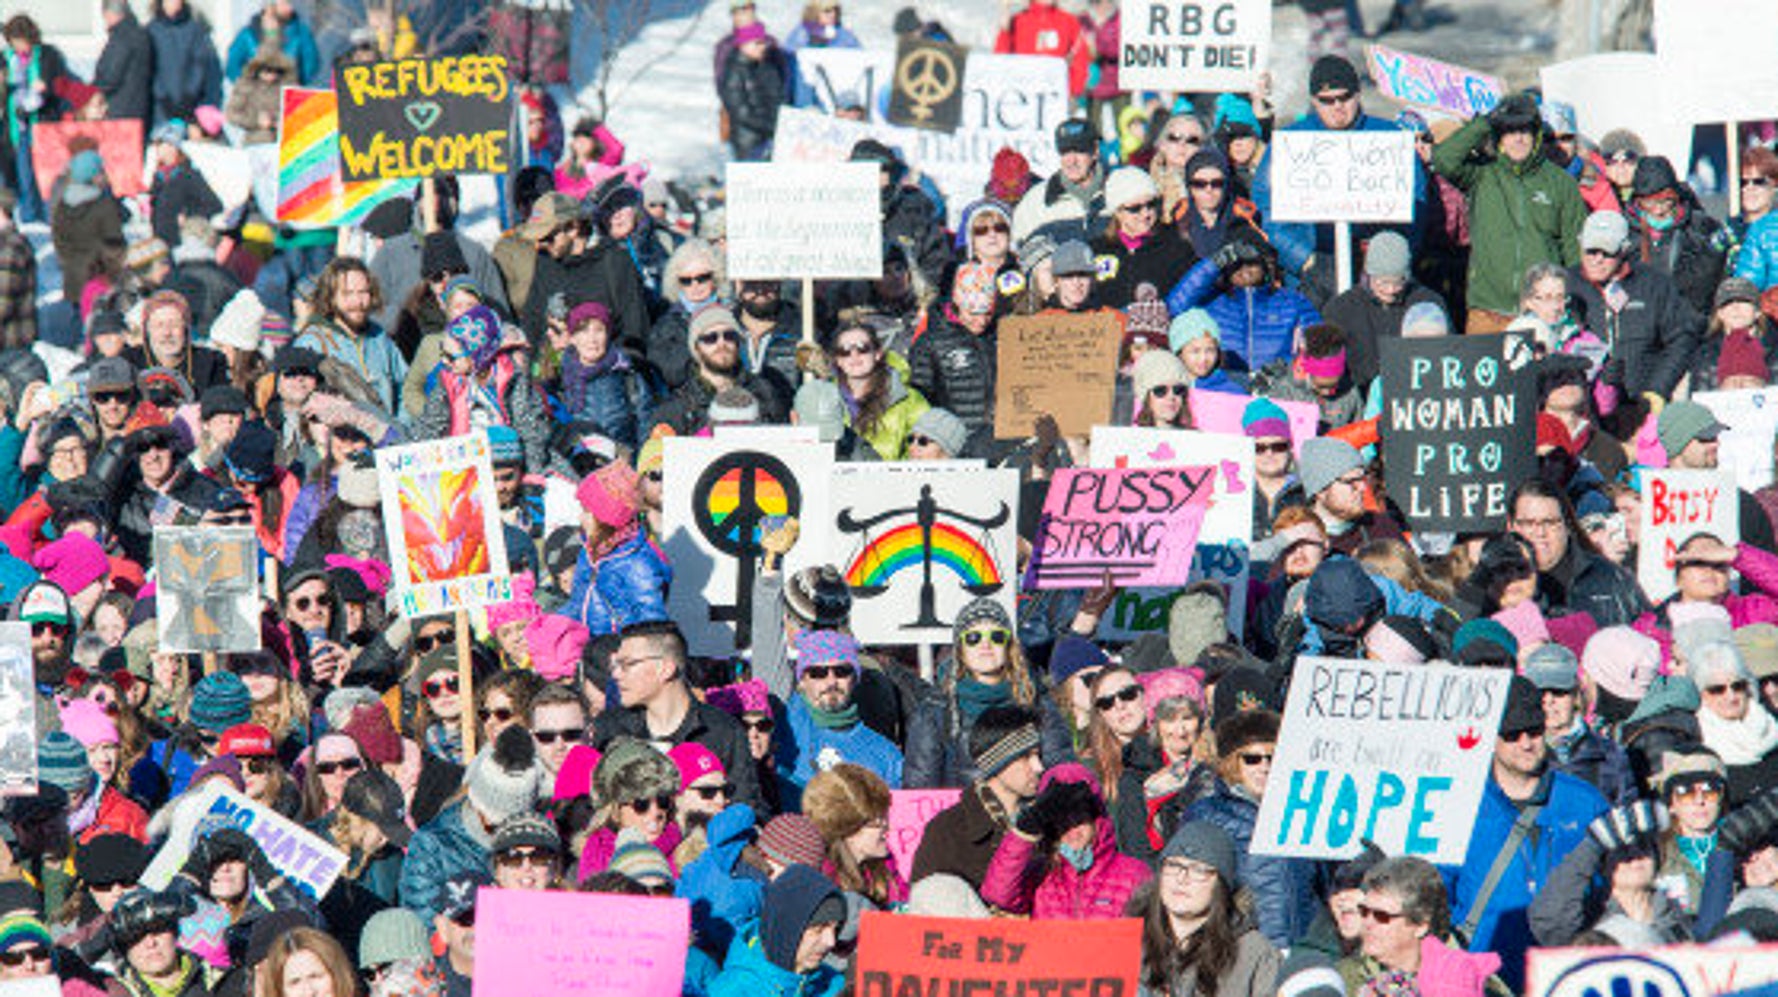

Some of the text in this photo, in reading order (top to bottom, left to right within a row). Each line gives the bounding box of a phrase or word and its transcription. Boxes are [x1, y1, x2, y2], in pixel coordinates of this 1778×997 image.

[344, 53, 508, 106] REFUGEES
[340, 129, 508, 178] WELCOME
[1411, 357, 1499, 389] PRO
[1392, 394, 1516, 431] WOMAN
[1414, 442, 1502, 475] PRO
[1062, 467, 1212, 516] PUSSY
[1042, 517, 1166, 558] STRONG
[1306, 665, 1498, 721] REBELLIONS
[1277, 770, 1454, 855] HOPE
[254, 820, 338, 887] HATE
[976, 936, 1026, 963] My
